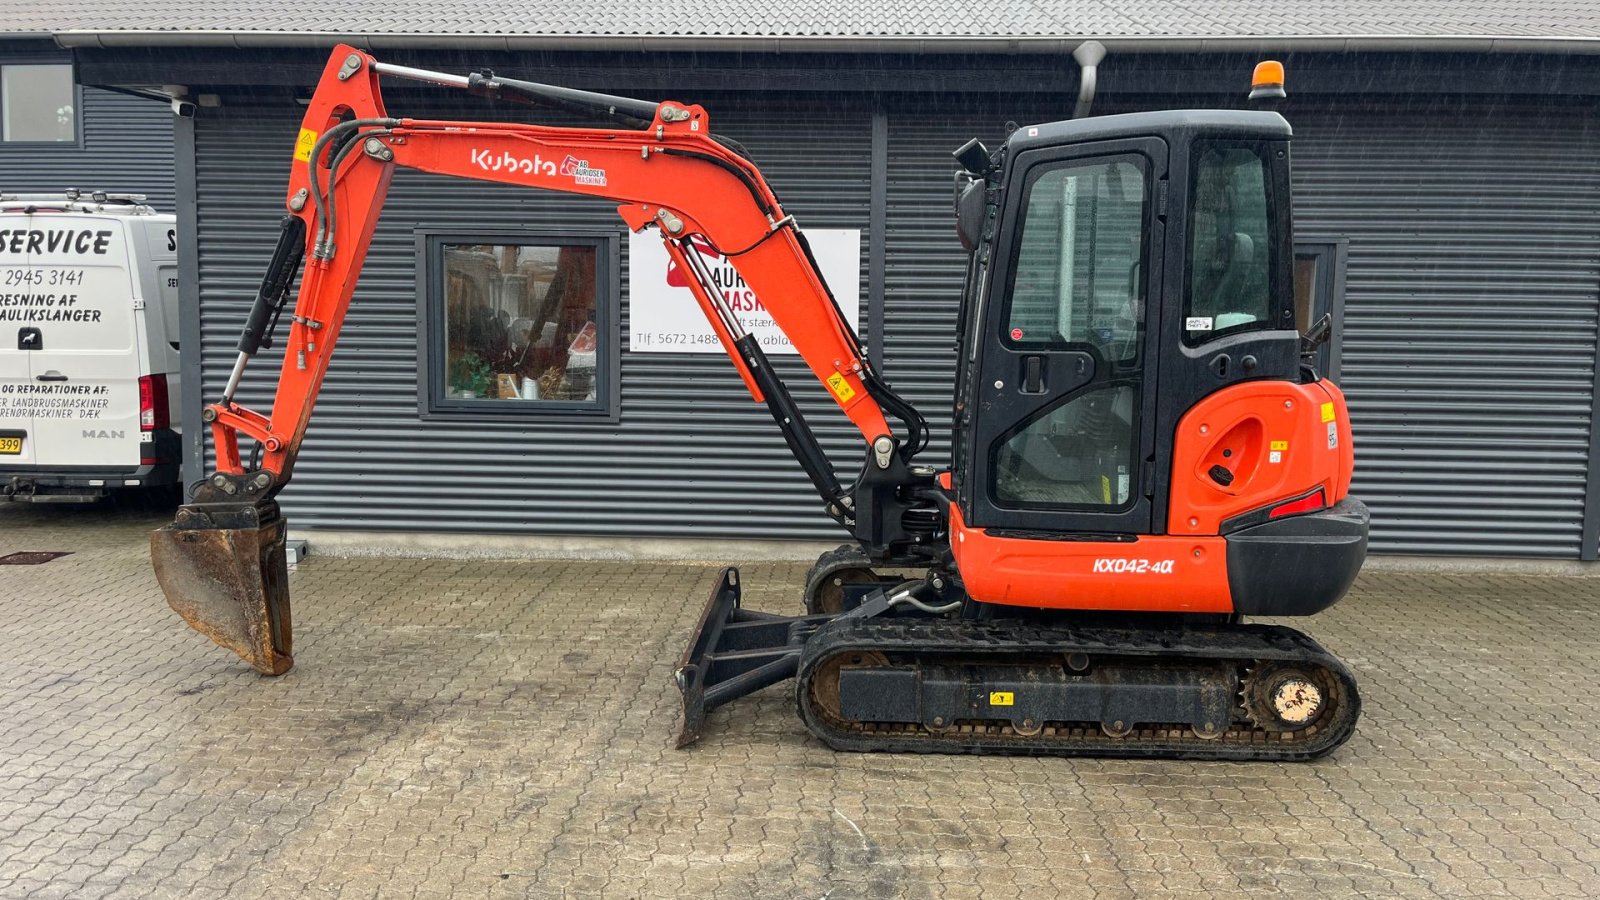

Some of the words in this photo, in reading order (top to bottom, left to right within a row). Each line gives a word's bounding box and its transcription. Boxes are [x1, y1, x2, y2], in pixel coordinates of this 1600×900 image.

[471, 148, 557, 176] Kubota
[0, 229, 112, 255] SERVICE
[5, 270, 43, 287] 2945
[48, 270, 84, 286] 3141
[58, 295, 78, 307] AF
[636, 333, 655, 346] Tlf.
[658, 333, 687, 344] 5672
[690, 334, 719, 344] 1488
[2, 385, 14, 394] OG
[17, 385, 91, 395] REPARATIONER
[12, 398, 109, 408] LANDBRUGSMASKINER
[79, 410, 101, 419] DÆK
[82, 430, 125, 439] MAN
[0, 440, 19, 450] 399
